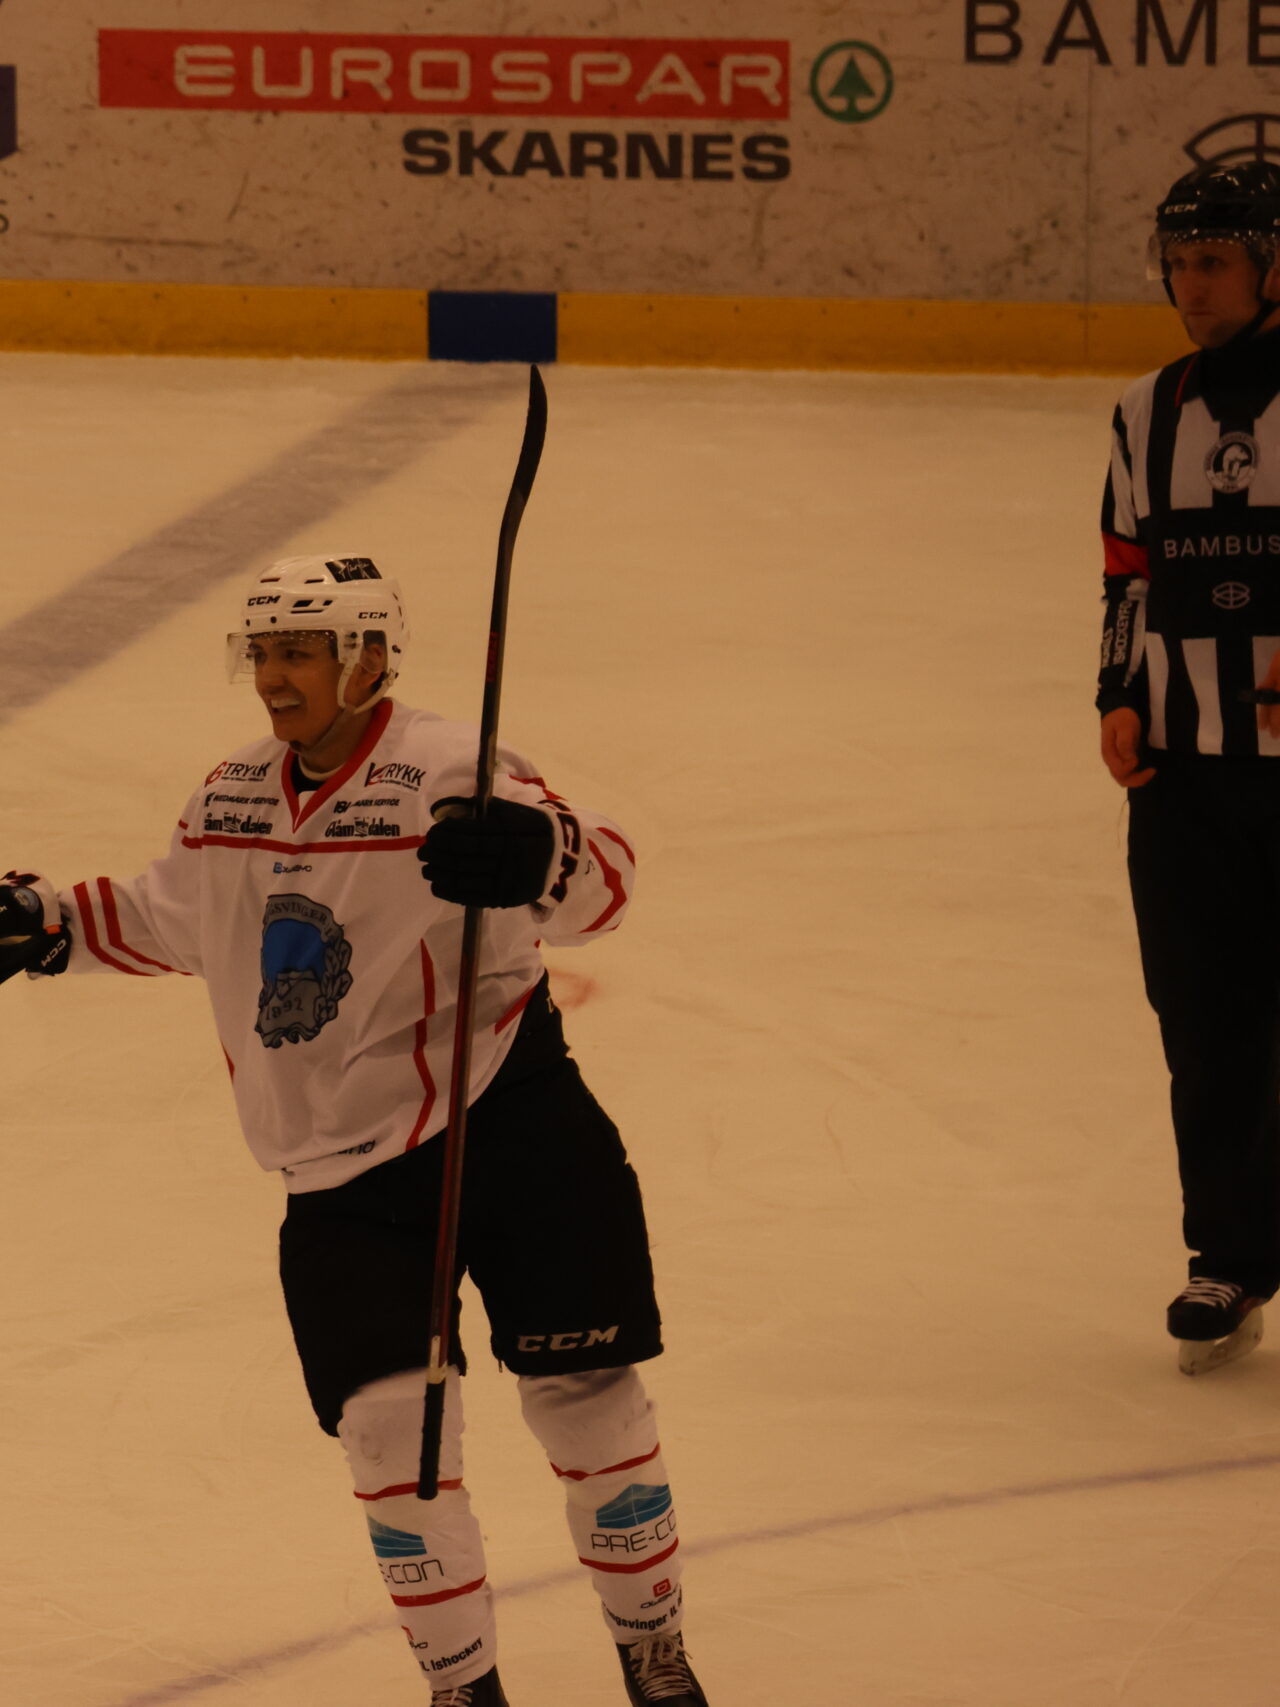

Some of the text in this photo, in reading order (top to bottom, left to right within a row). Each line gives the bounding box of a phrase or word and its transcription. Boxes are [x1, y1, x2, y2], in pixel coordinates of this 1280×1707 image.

[174, 45, 783, 107] EUROSPAR
[402, 128, 791, 181] SKARNES
[1163, 534, 1280, 559] BAMBUS
[247, 595, 281, 606] CCM
[358, 611, 388, 619] CCM
[40, 938, 67, 967] CCM
[517, 1325, 620, 1353] CCM
[431, 1637, 483, 1671] Ishockey
